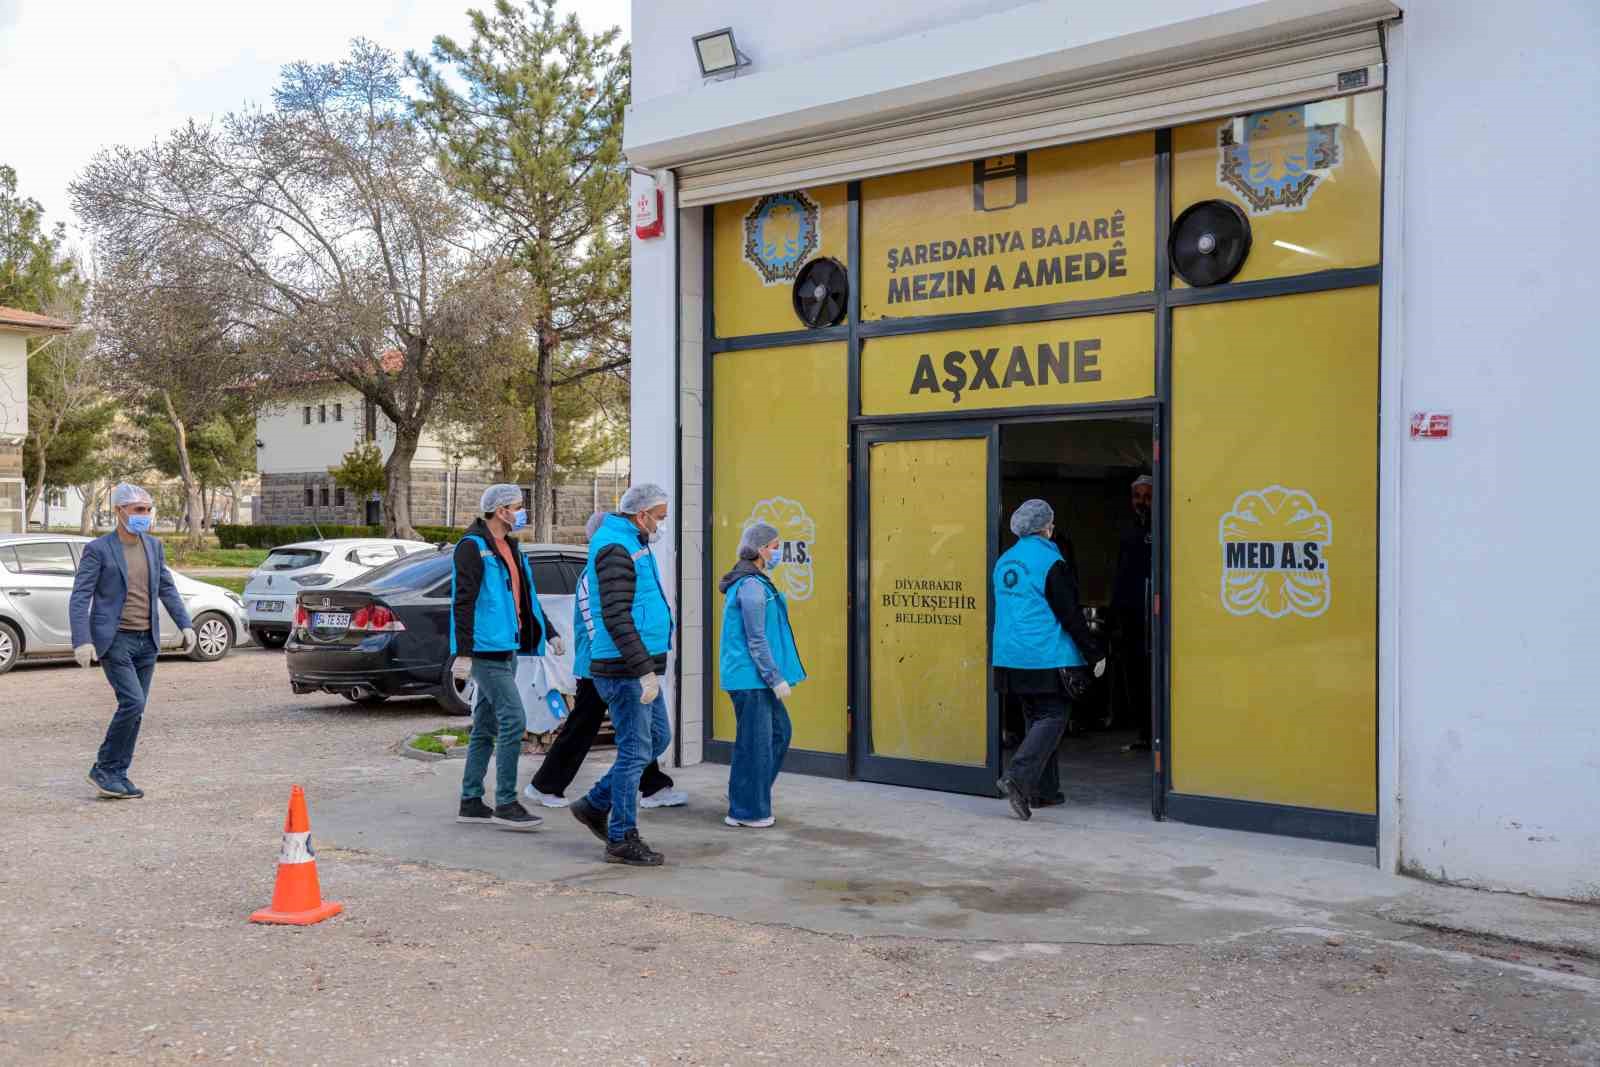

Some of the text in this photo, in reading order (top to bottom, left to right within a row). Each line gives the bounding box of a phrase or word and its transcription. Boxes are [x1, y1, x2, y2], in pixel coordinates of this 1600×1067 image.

[887, 208, 1126, 273] ŞAREDARIYA BAJARÊ
[887, 240, 1128, 304] MEZIN A AMEDÊ
[909, 338, 1102, 403] AŞXANE
[1226, 542, 1275, 569] MED
[881, 592, 977, 611] BÜYÜKŞEHİR
[895, 612, 962, 625] BELEDİYESİ
